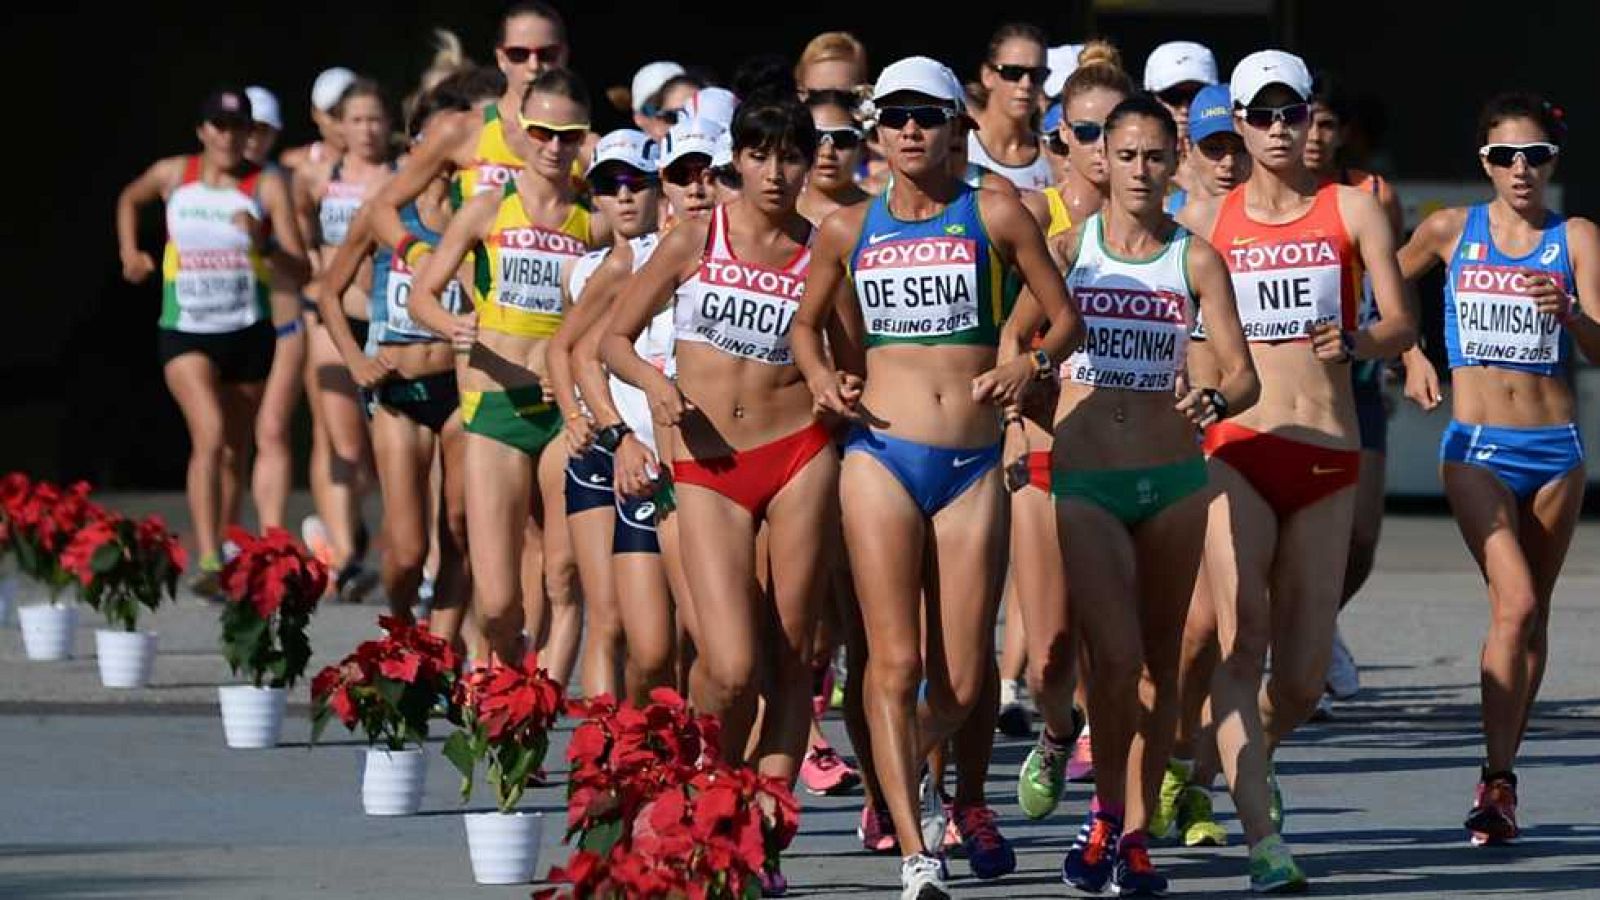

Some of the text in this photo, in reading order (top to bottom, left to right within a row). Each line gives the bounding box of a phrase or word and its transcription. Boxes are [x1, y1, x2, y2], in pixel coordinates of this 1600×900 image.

[863, 241, 971, 267] TOYOTA
[1231, 241, 1336, 269] TOYOTA
[863, 274, 971, 308] DE SENA
[1257, 277, 1312, 310] NIE
[1076, 292, 1184, 321] TOYOTA
[871, 312, 971, 333] BEIJING 2015
[1243, 320, 1299, 337] BEIJING
[697, 326, 757, 355] BEIJING
[1519, 346, 1553, 360] 2015
[1077, 365, 1172, 388] BEIJING 2015
